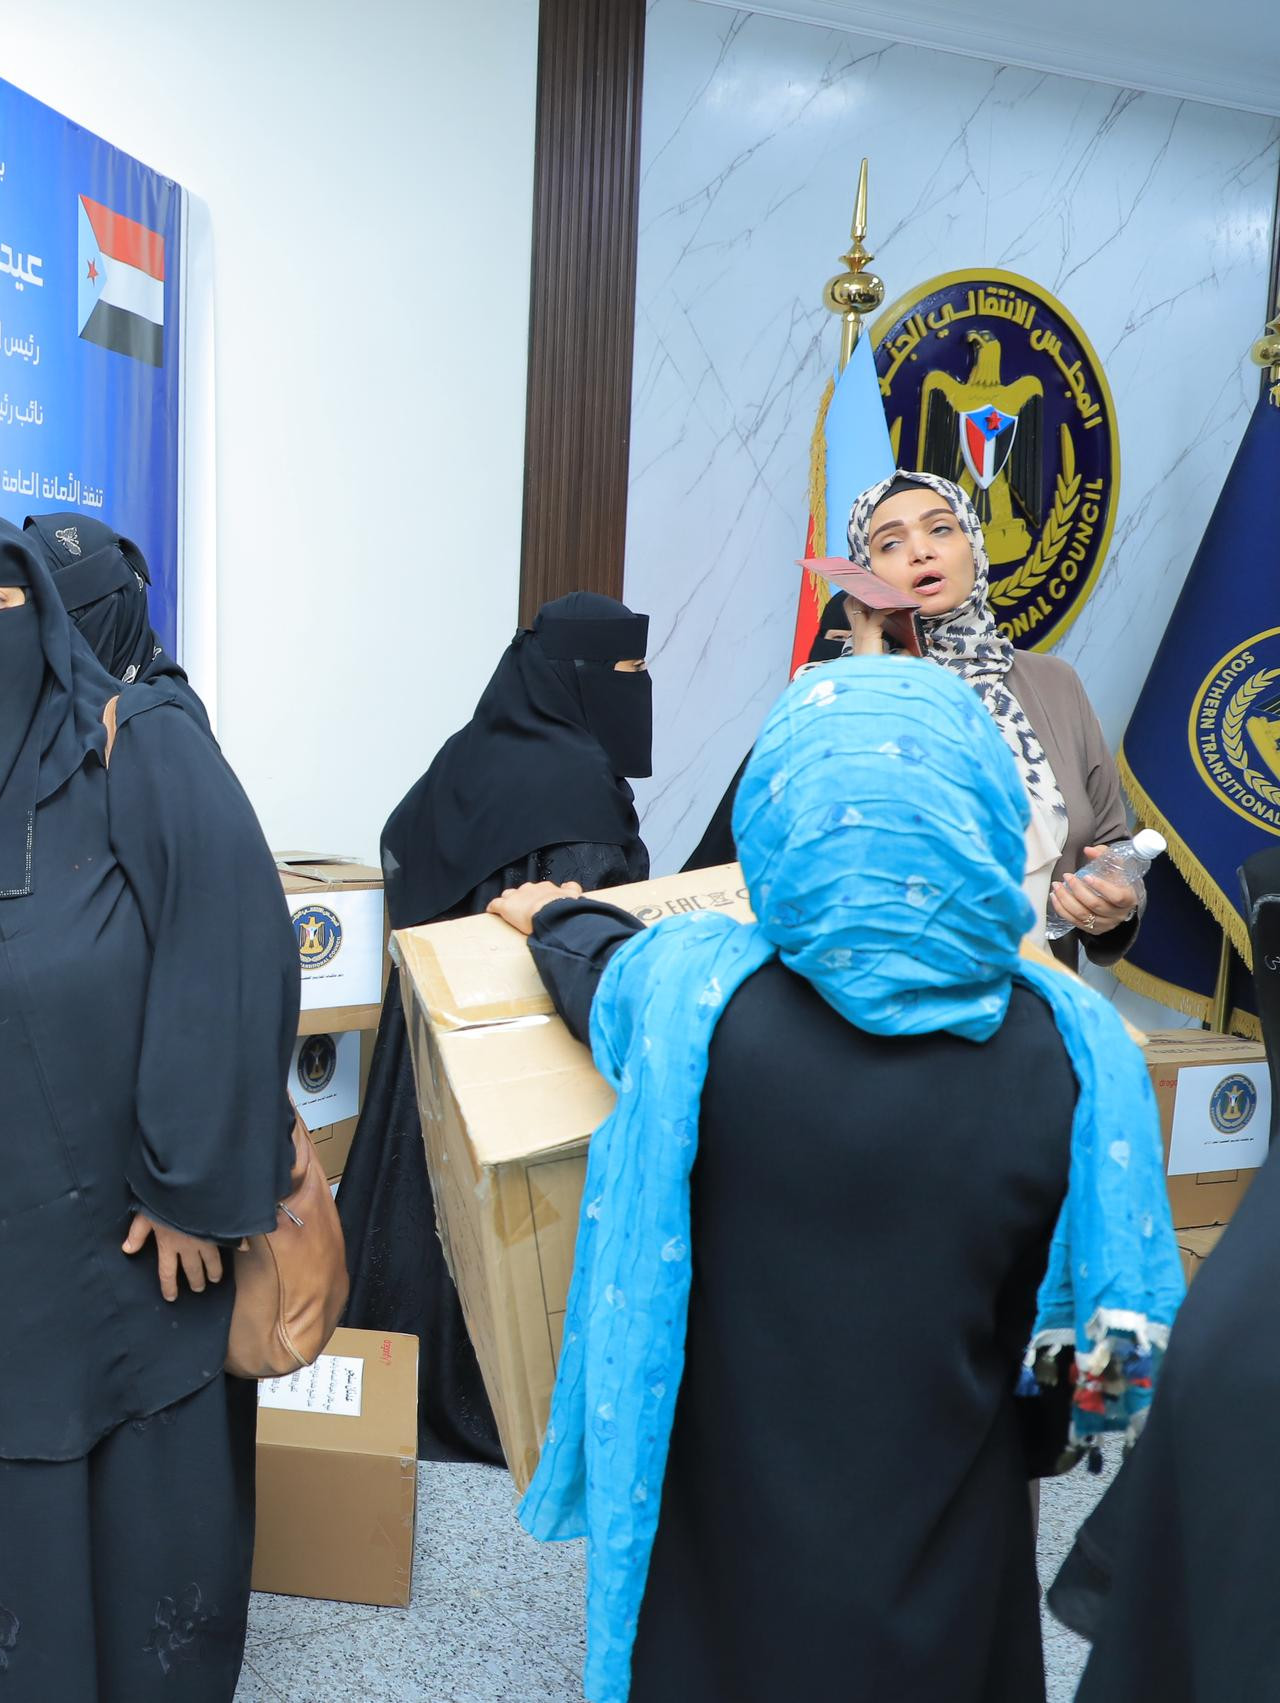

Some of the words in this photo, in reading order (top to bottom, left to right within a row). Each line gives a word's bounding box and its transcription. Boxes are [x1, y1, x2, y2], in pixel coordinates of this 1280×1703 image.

[925, 286, 1037, 339] الانتقالي
[4, 334, 40, 365] رئيس
[1030, 328, 1103, 429] المجلس
[15, 400, 43, 425] نائب
[2, 469, 39, 499] العامة
[42, 472, 80, 505] الأمانة
[1048, 478, 1104, 600] COUNCIL
[1200, 651, 1255, 729] SOUTHERN
